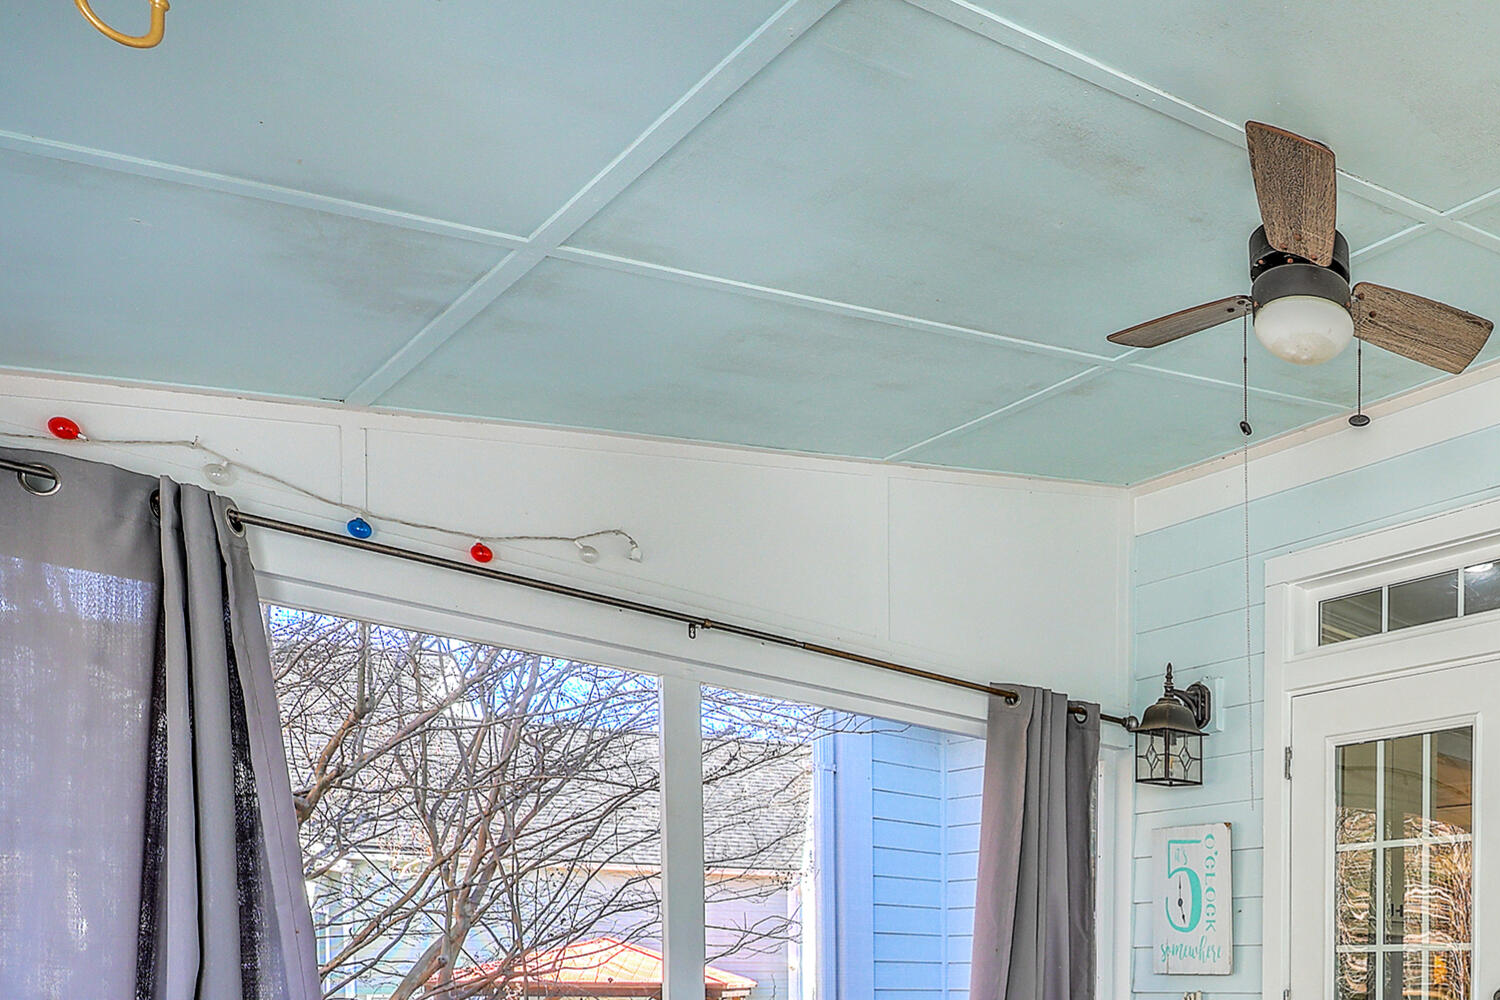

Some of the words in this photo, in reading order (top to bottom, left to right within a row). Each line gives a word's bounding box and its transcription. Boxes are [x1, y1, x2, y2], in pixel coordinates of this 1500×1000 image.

[1166, 839, 1202, 933] 5
[1204, 833, 1218, 932] O'CLOCK
[1160, 935, 1222, 963] somewhere
